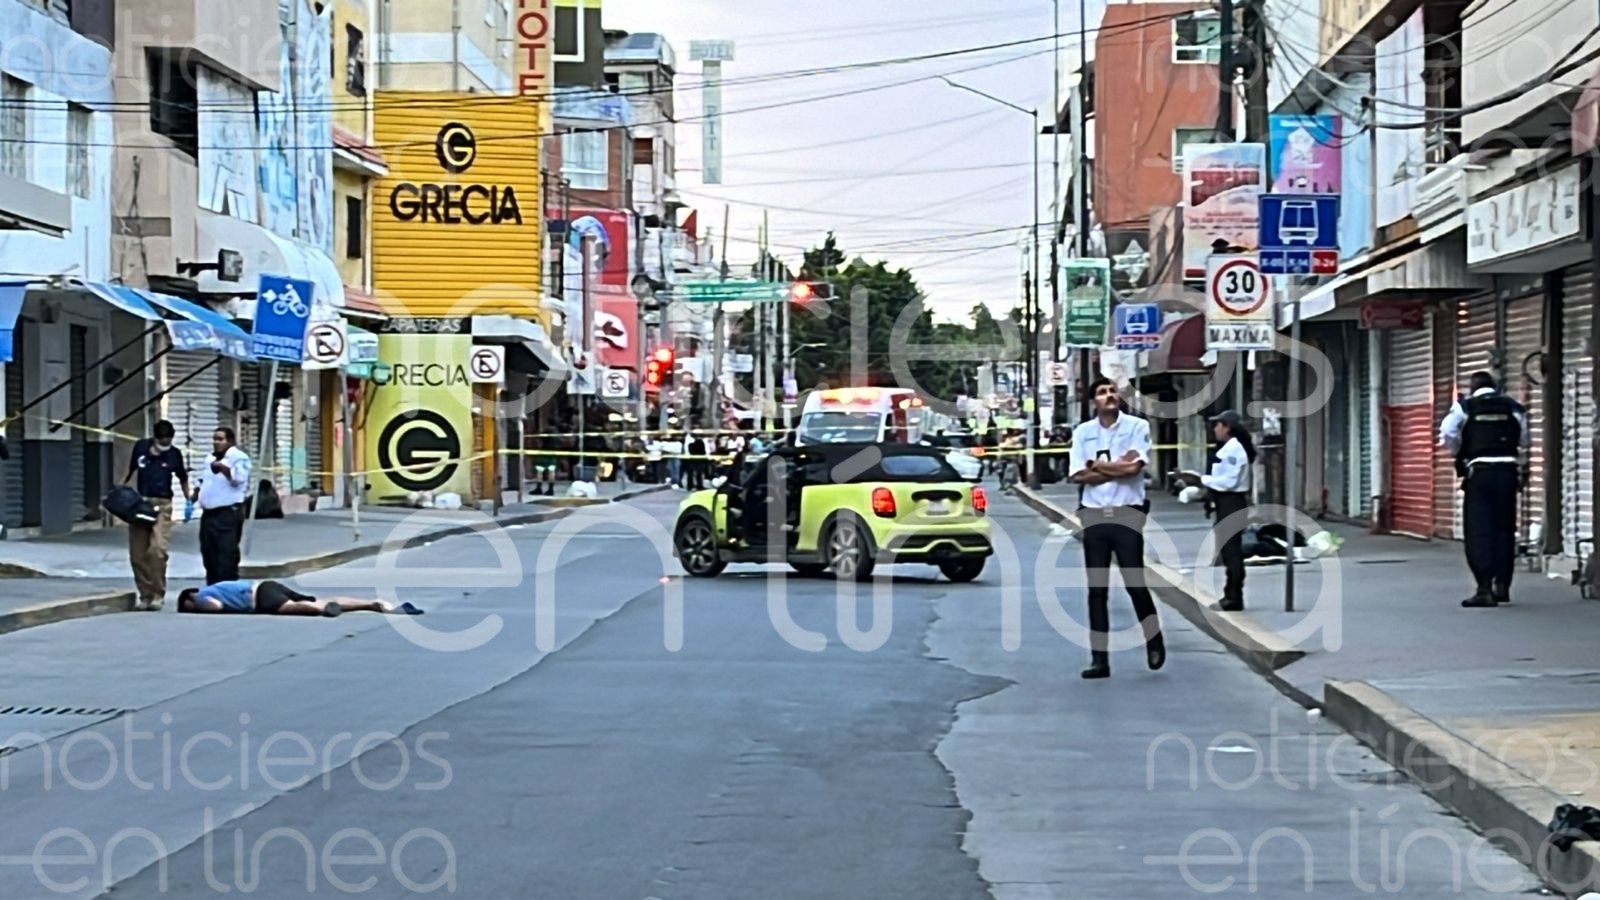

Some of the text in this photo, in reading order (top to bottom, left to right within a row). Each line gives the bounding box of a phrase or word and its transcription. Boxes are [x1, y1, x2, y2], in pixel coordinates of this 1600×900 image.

[517, 0, 548, 96] OTE
[389, 182, 522, 225] GRECIA
[1226, 270, 1255, 294] 30
[371, 363, 470, 386] GRECIA
